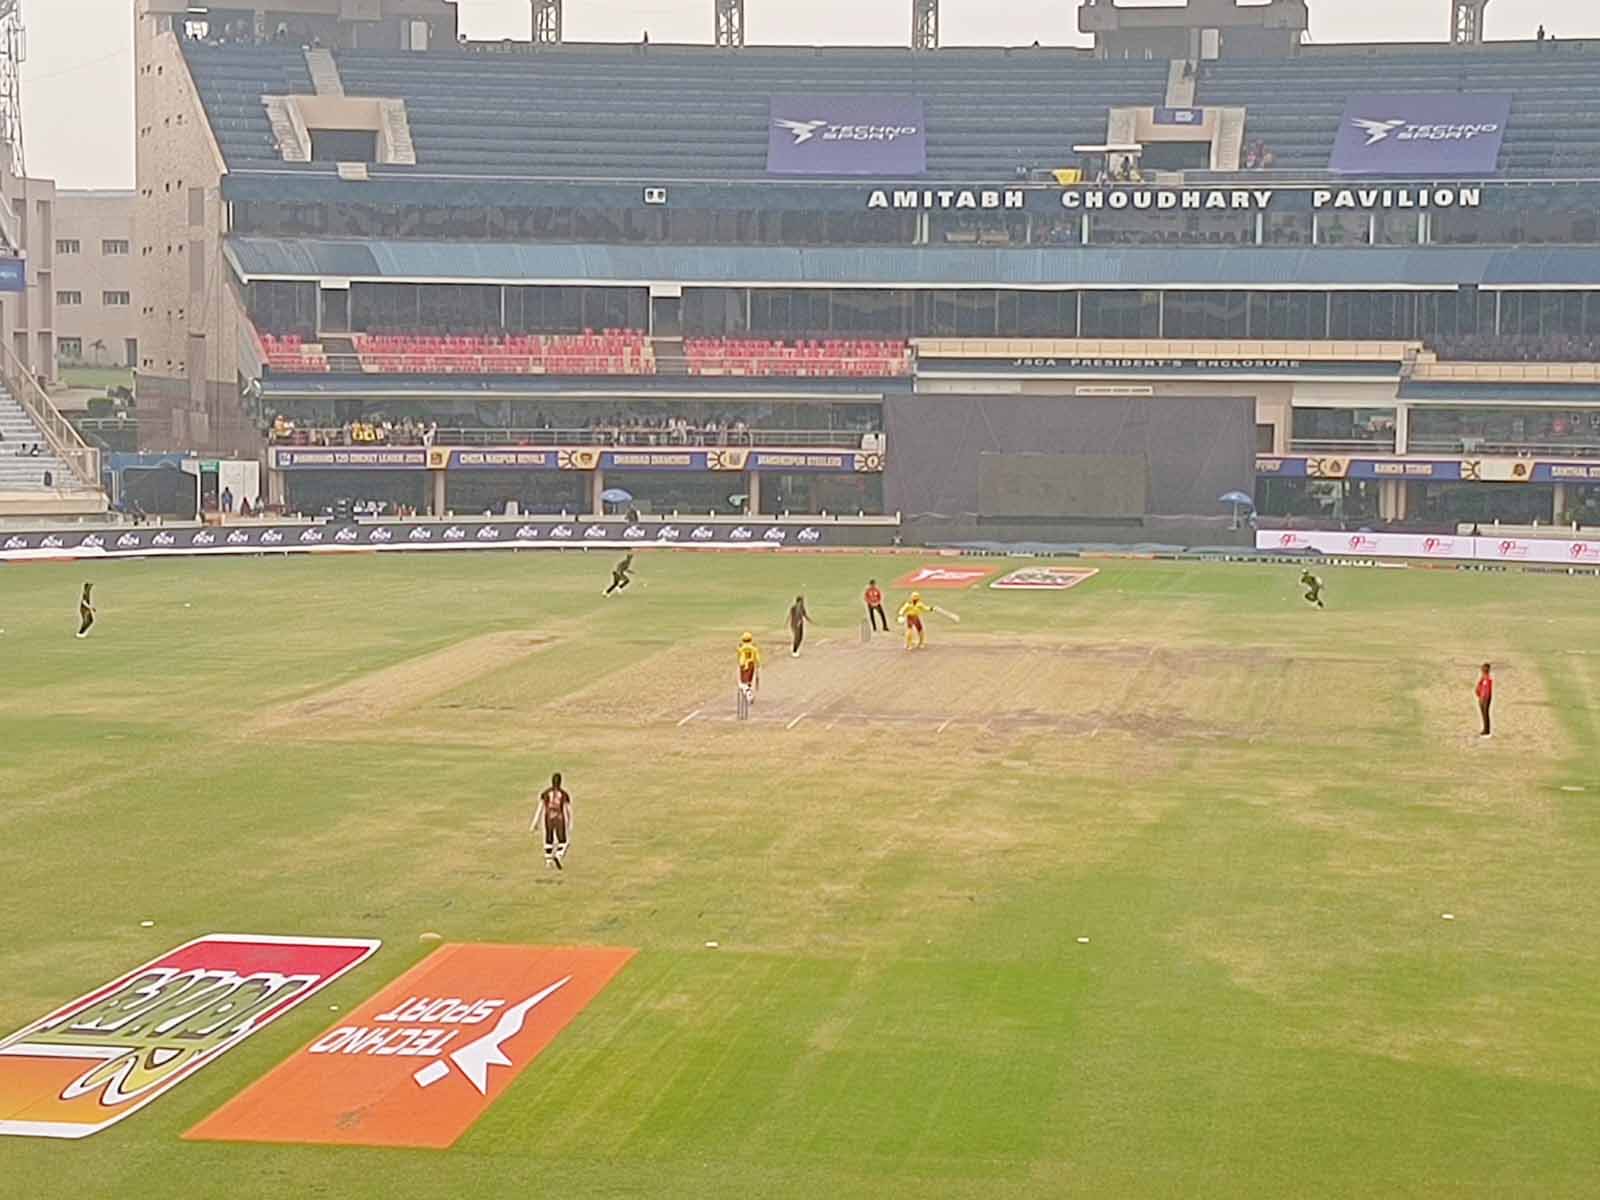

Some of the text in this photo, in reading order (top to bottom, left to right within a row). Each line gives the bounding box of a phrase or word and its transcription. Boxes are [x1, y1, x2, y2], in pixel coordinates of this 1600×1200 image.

[828, 125, 917, 135] TECHNO
[1405, 124, 1498, 133] TECHNO
[867, 189, 1481, 209] AMITABH CHOUDHARY PAVILION
[1012, 358, 1300, 368] JSCA PRESIDENT'S ENCLOSURE
[374, 997, 505, 1024] SPORT
[308, 1026, 460, 1056] TECHNO
